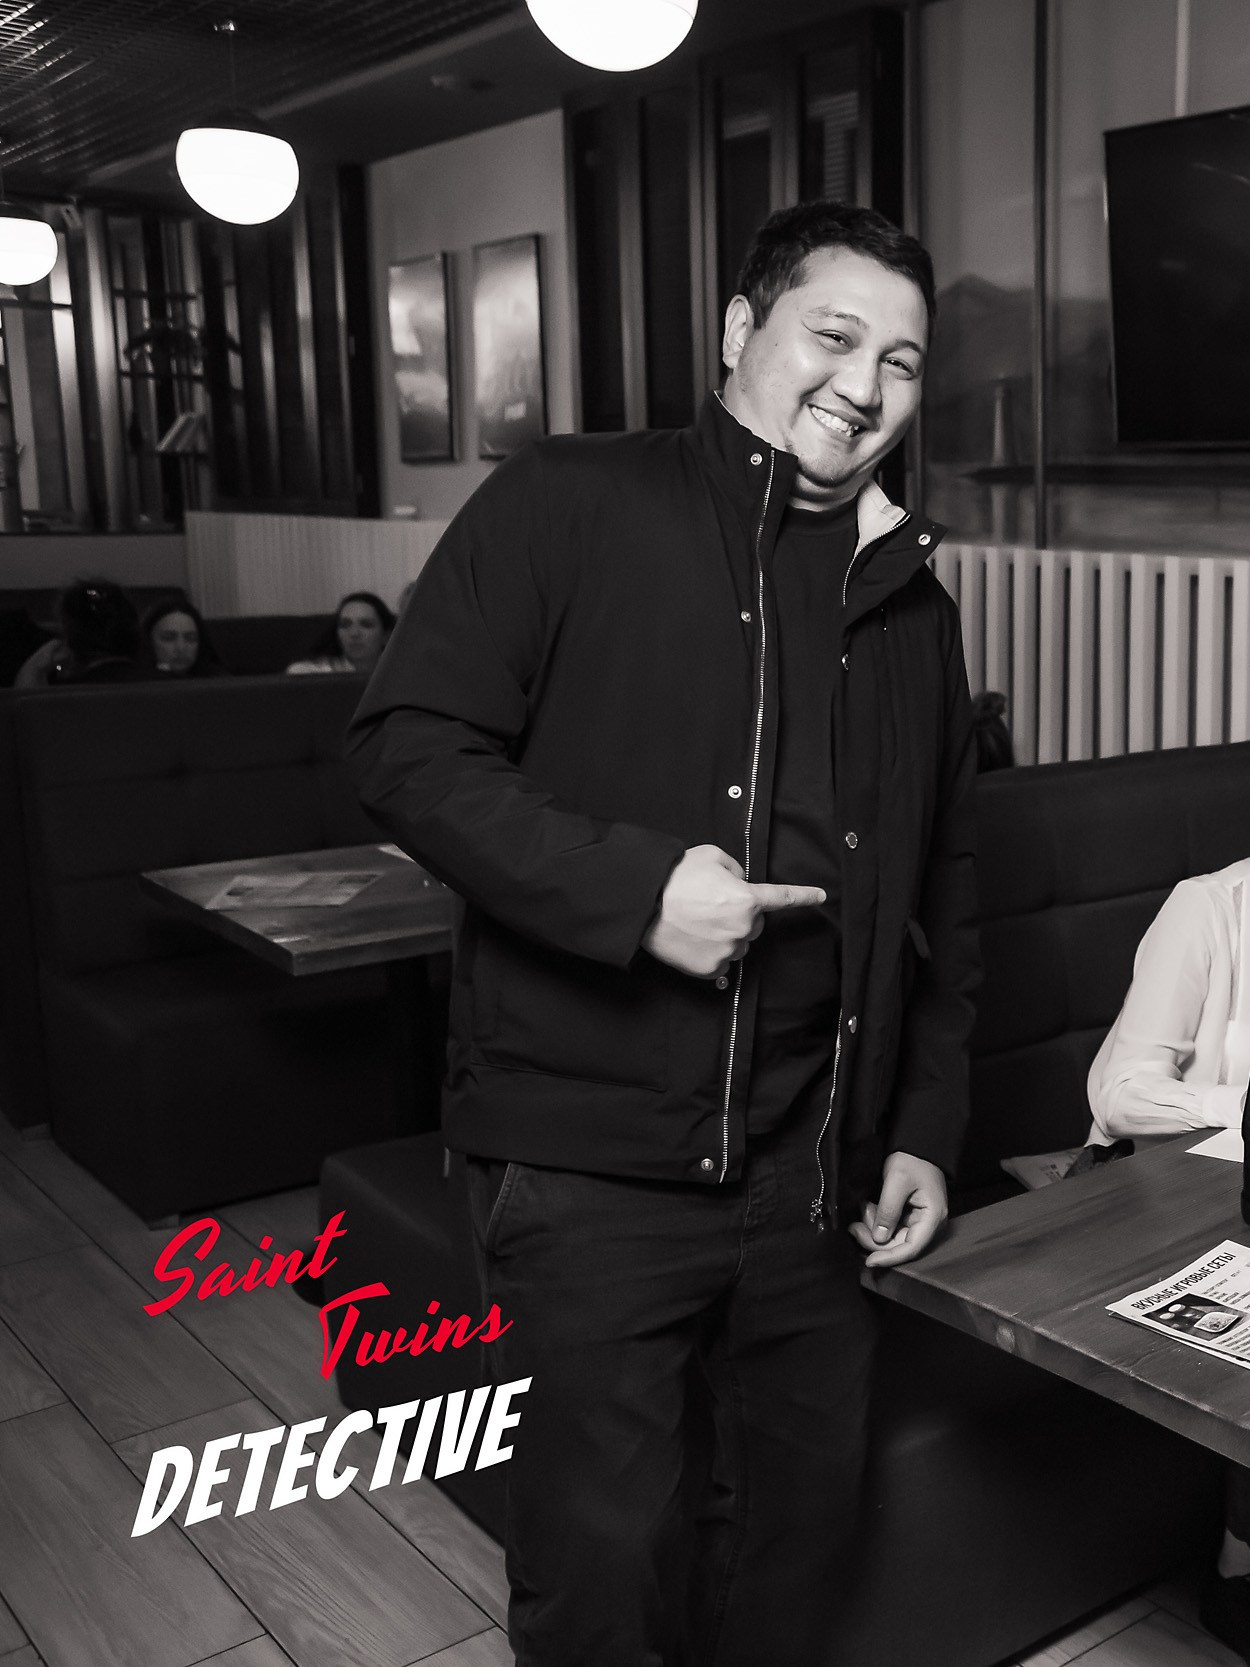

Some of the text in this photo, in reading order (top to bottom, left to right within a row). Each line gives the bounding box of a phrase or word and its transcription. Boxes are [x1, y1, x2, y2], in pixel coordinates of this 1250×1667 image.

[1130, 1287, 1177, 1310] ВКУСНЫЕ
[1171, 1266, 1214, 1292] ИГРОВЫЕ
[1206, 1252, 1236, 1270] СЕТЫ
